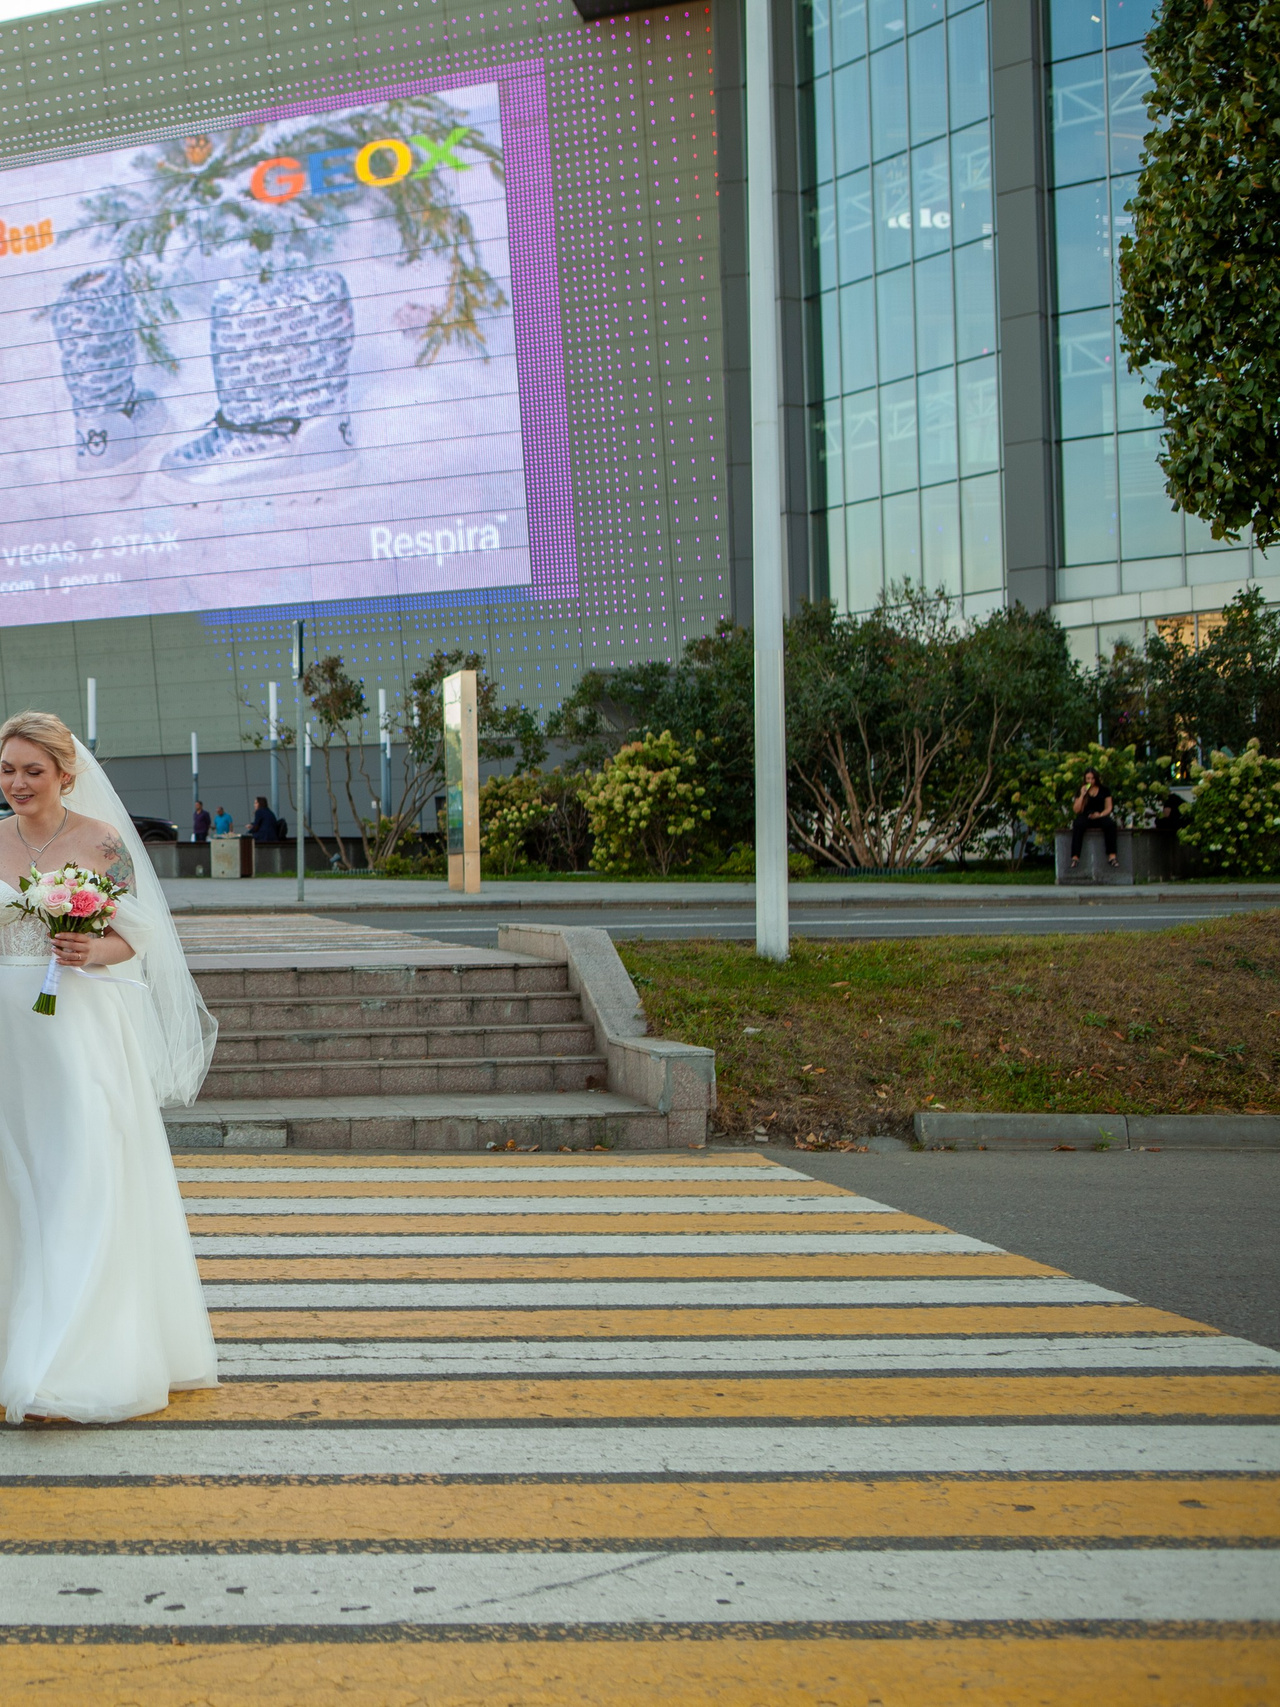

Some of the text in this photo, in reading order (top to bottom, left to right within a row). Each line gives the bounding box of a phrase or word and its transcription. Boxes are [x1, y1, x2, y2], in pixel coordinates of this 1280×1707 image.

[251, 127, 471, 205] GEOX
[2, 541, 84, 566] VEGAS,
[91, 537, 105, 560] 2
